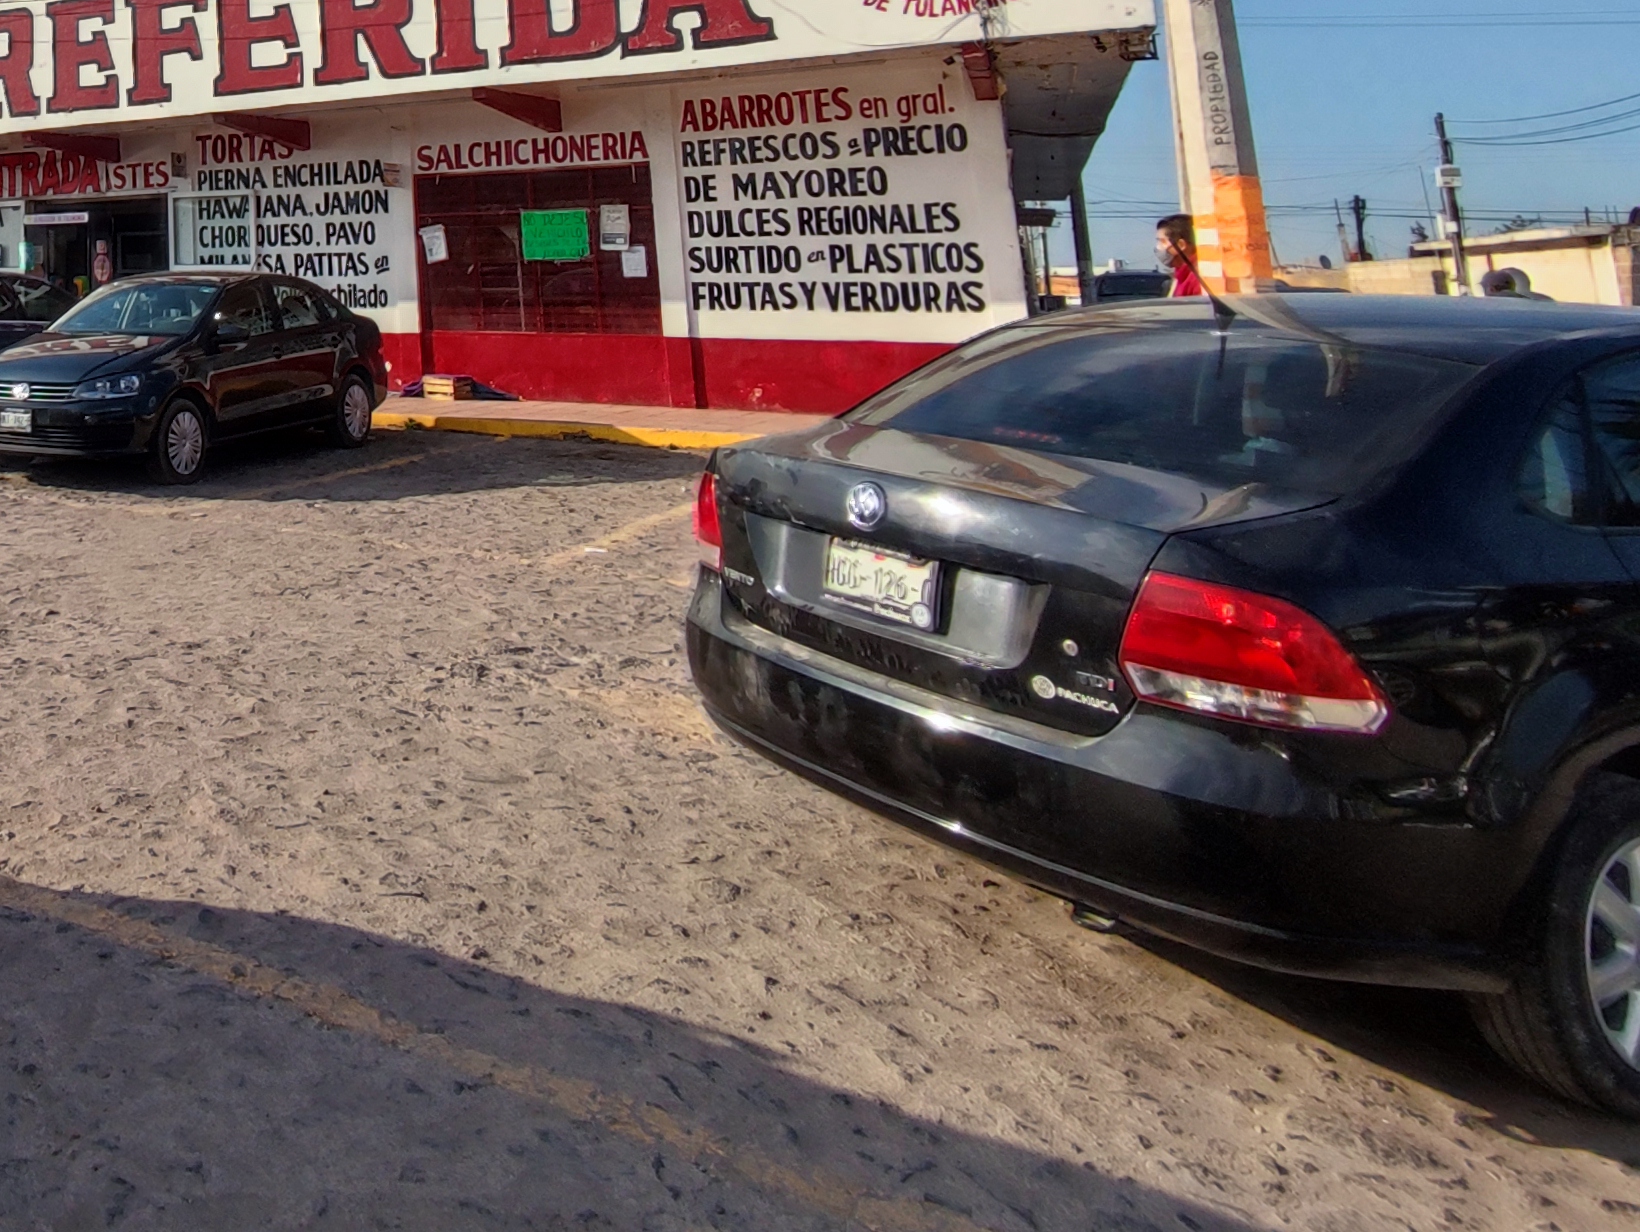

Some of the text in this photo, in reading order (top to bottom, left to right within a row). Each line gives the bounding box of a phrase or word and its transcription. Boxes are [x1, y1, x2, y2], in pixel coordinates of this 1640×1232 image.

[680, 84, 956, 133] ABARROTES en gral.
[196, 133, 294, 165] TORTAS
[417, 130, 650, 171] SALCHICHONERIA
[681, 130, 841, 167] REFRESCOS
[863, 123, 968, 157] PRECIO
[197, 159, 386, 191] PIERNA ENCHILADA
[684, 166, 889, 203] DE MAYOREO
[315, 189, 389, 216] JAMON
[325, 220, 376, 245] PAVO
[687, 202, 961, 238] DULCES REGIONALES
[294, 252, 370, 277] PATITAS
[374, 255, 390, 275] en
[688, 242, 985, 274] SURTIDO en PLASTICOS
[691, 281, 986, 313] FRUTAS Y VERDURAS
[1057, 687, 1120, 714] PACHUCA
